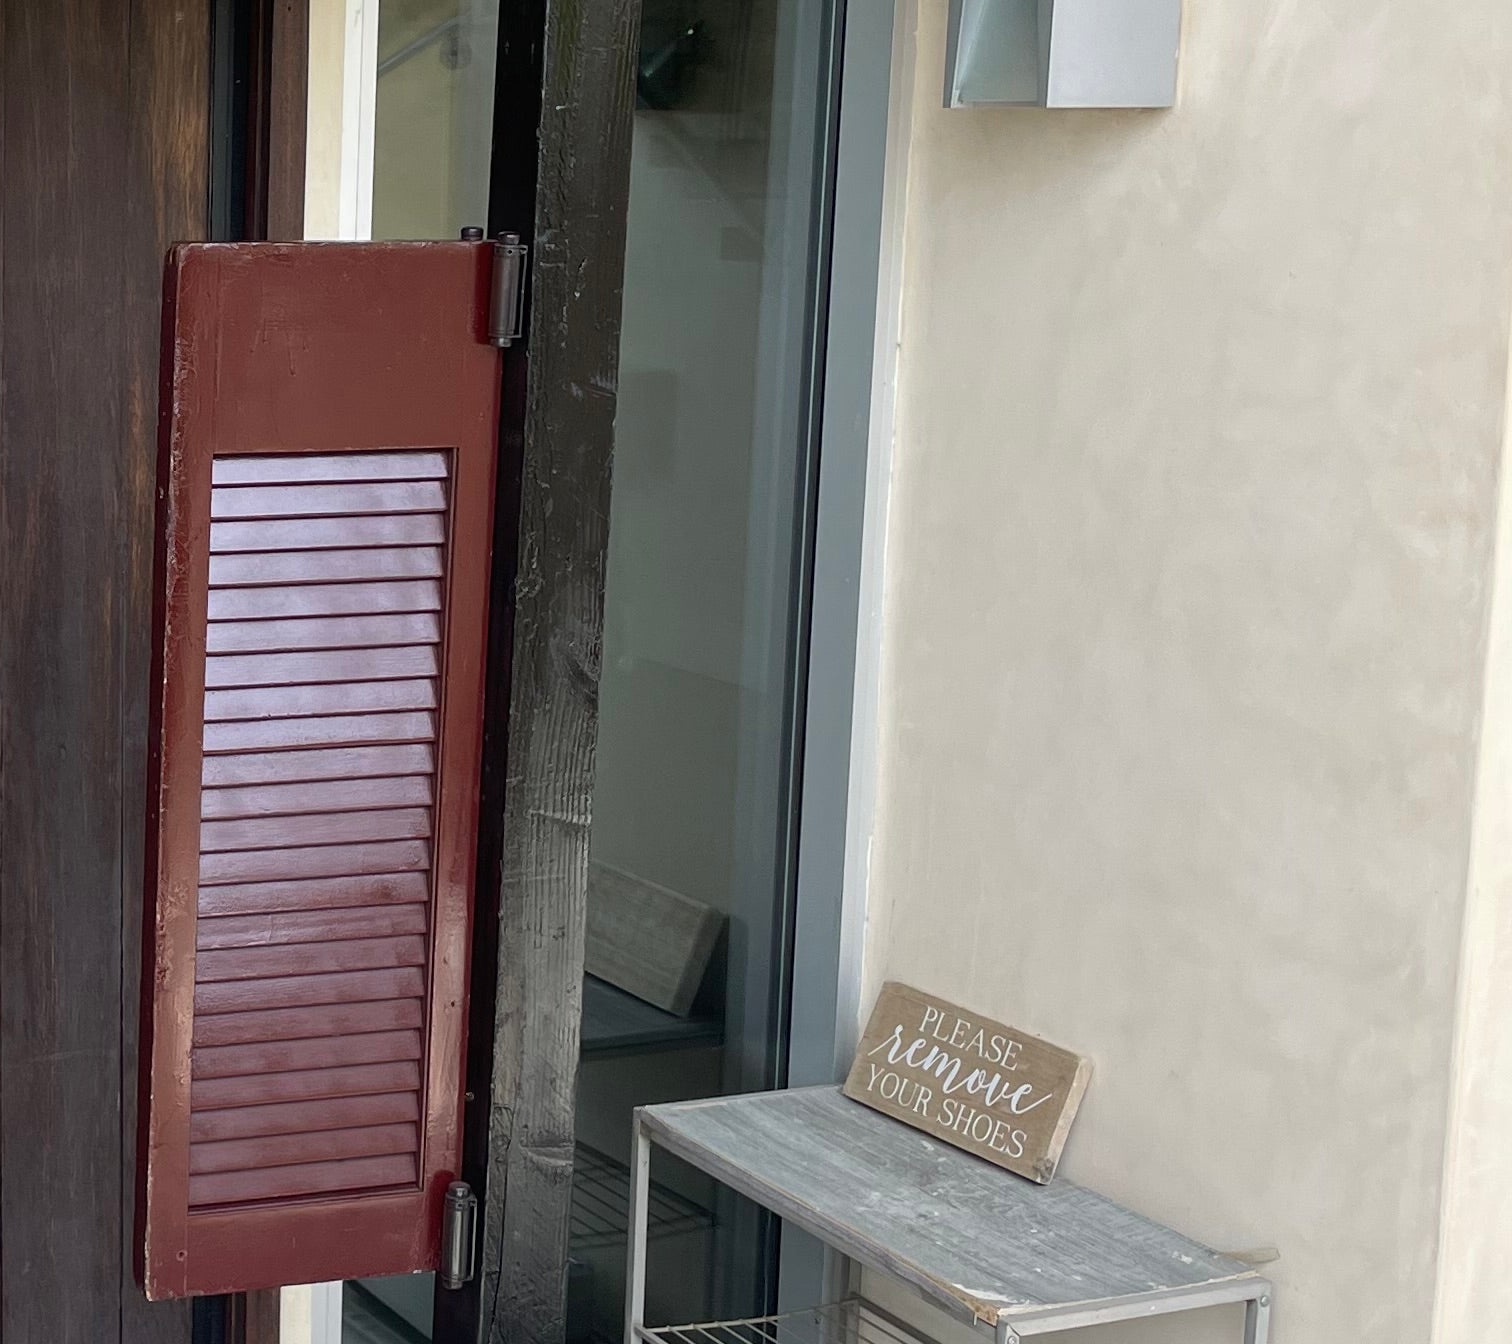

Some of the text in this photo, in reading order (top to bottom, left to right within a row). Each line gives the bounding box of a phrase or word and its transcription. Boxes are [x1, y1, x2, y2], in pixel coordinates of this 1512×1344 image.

[867, 1024, 1052, 1114] remove
[919, 1006, 1022, 1070] PLEASE
[867, 1064, 1028, 1158] YOUR SHOES
